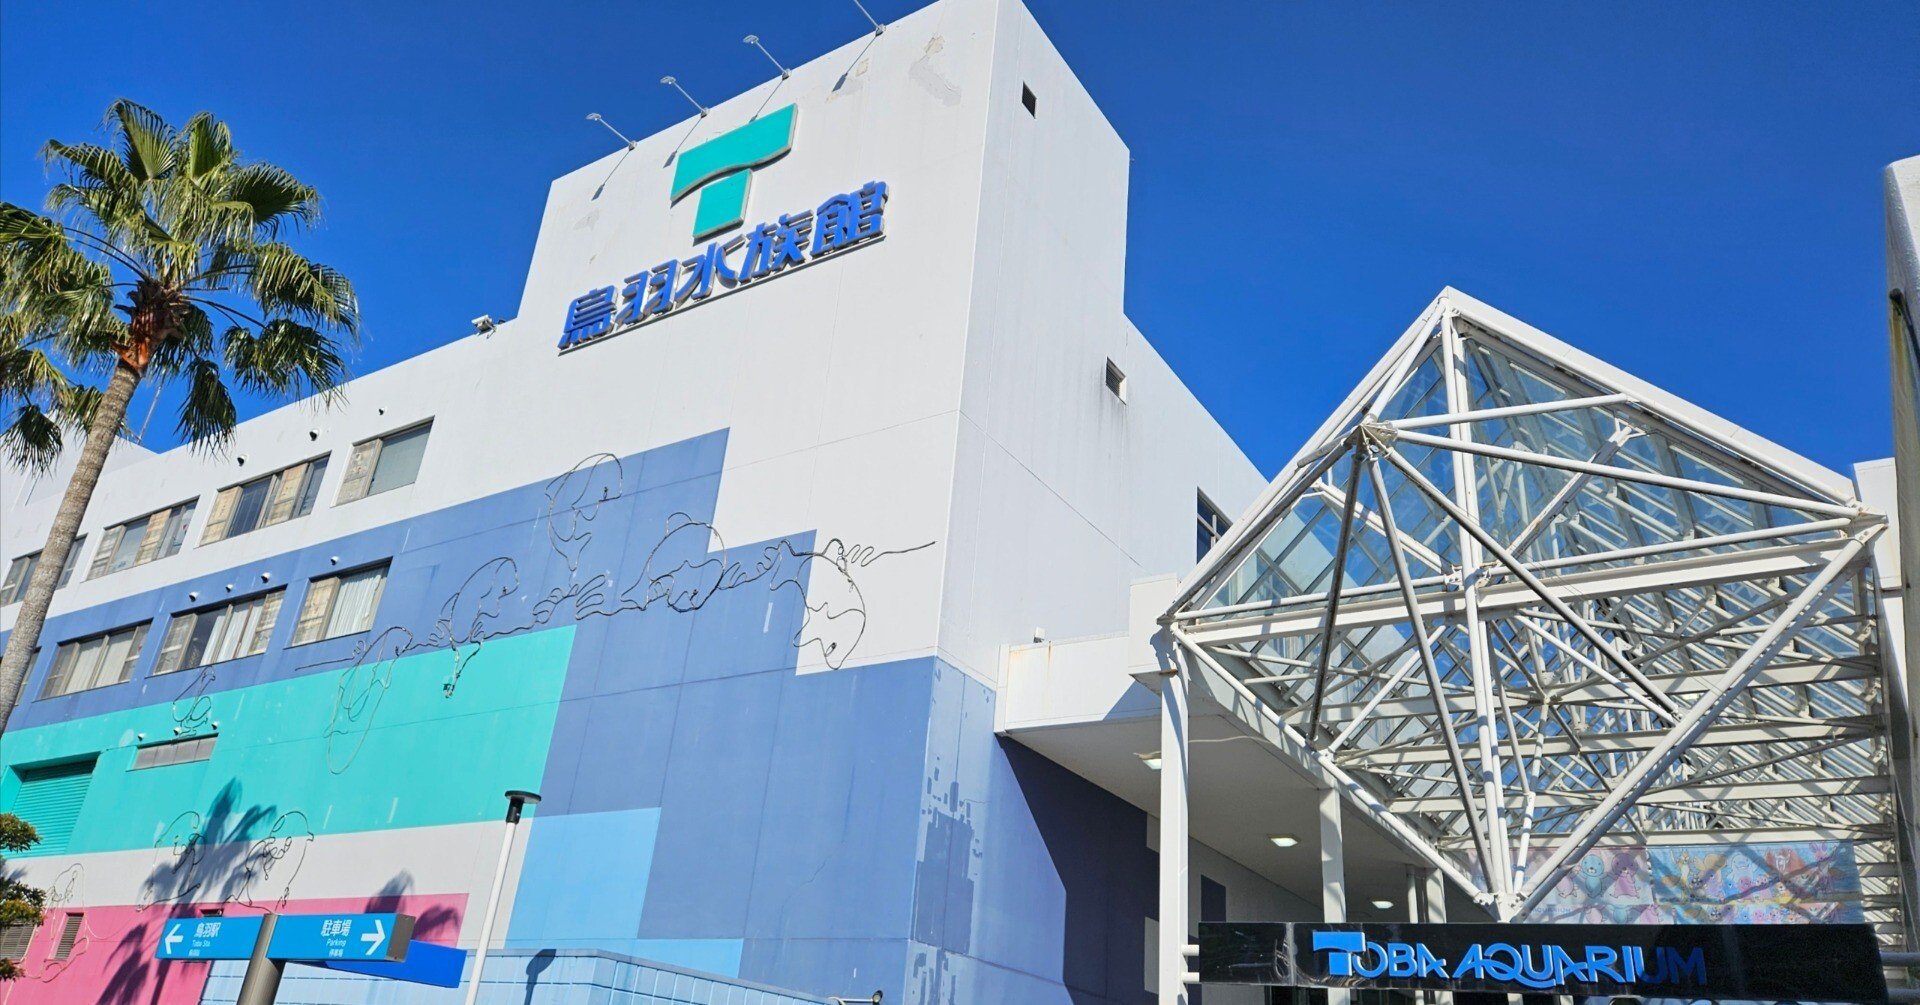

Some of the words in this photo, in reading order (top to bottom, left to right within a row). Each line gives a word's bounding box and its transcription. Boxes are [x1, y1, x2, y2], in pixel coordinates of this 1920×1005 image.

[557, 180, 889, 351] 鳥羽水族館
[193, 922, 221, 938] 鳥羽駅
[320, 919, 352, 937] 駐車場
[325, 938, 347, 948] Parking
[1313, 931, 1449, 980] TOBA
[1452, 942, 1707, 989] AQUARIUM
